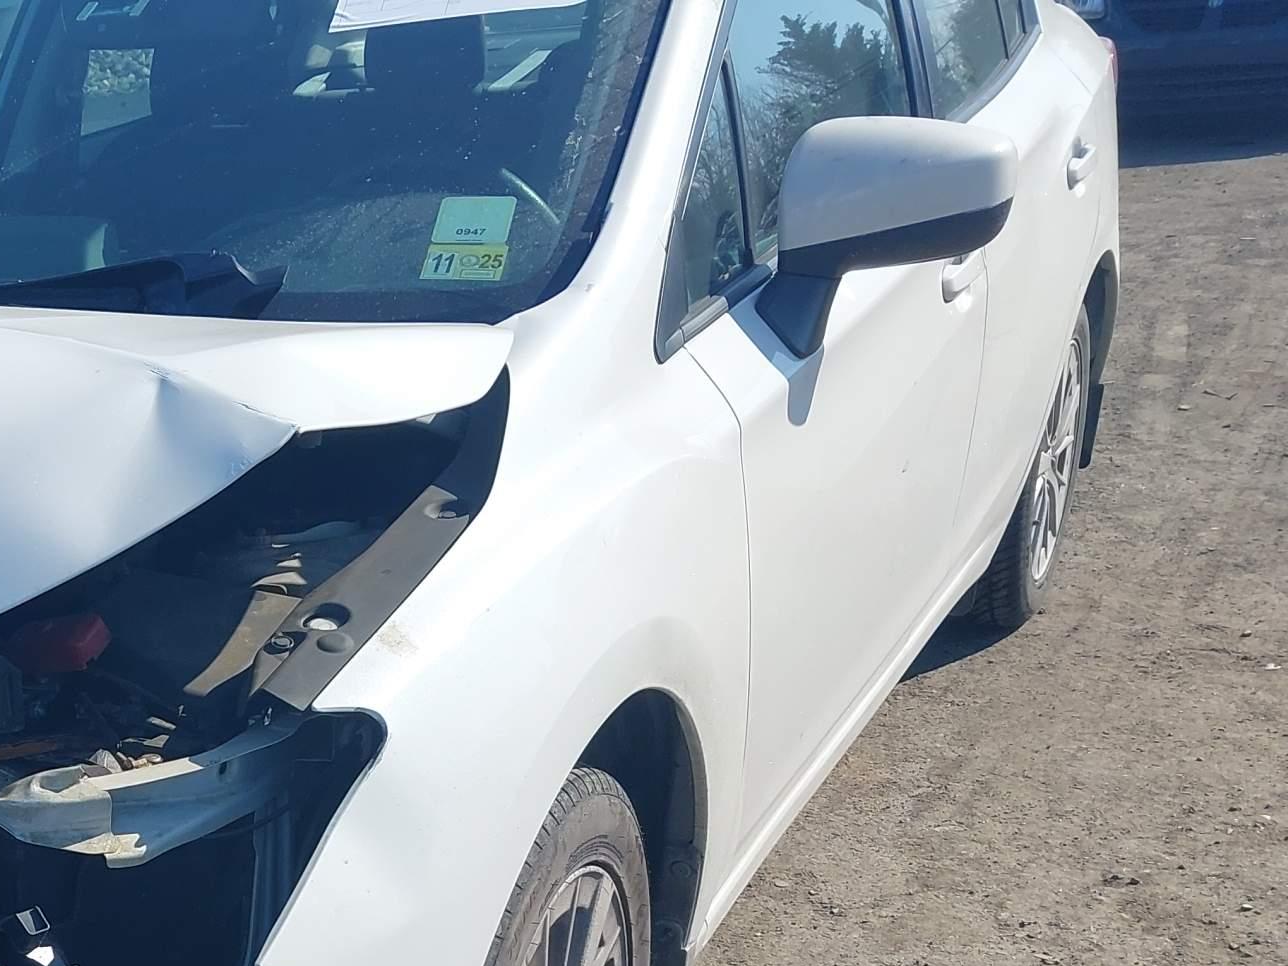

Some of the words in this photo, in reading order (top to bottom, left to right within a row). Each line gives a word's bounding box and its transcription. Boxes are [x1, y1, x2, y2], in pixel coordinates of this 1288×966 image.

[455, 228, 486, 236] 0947
[432, 253, 455, 273] 11
[478, 254, 504, 269] 25
